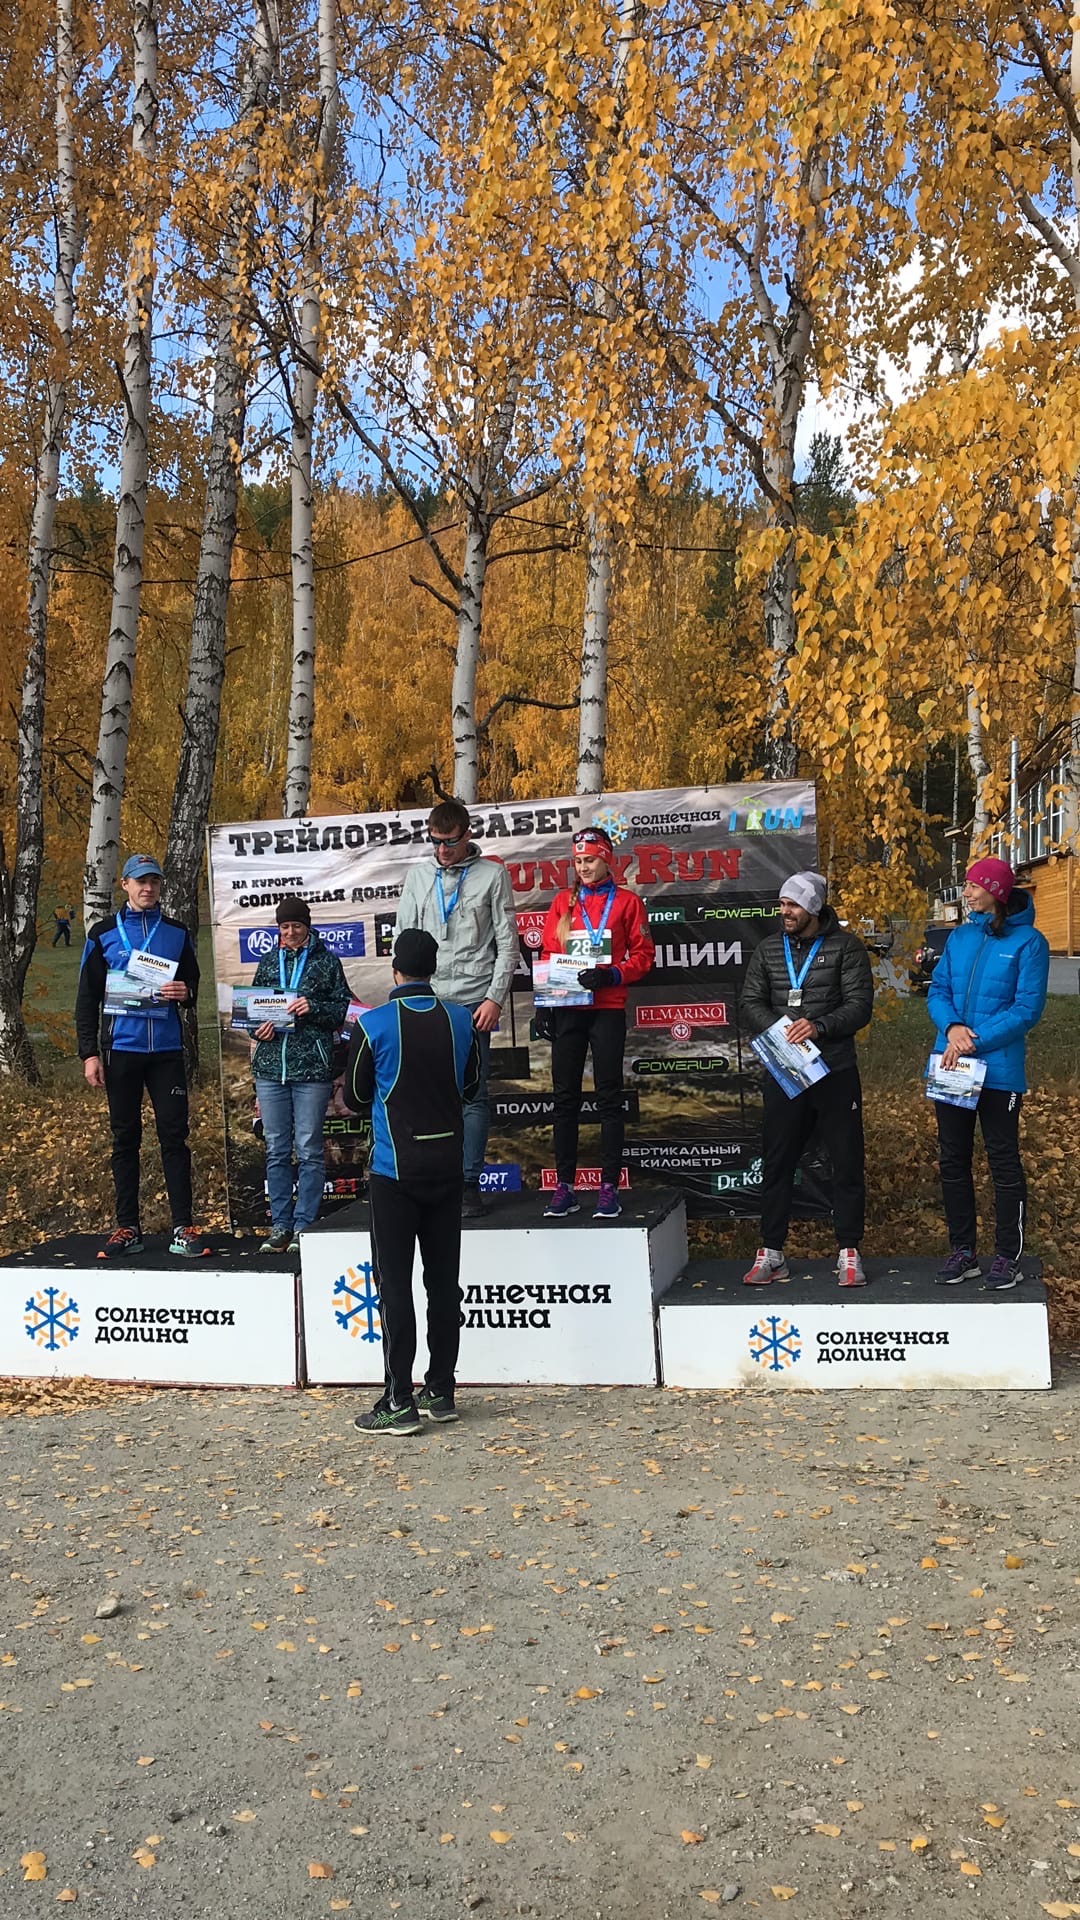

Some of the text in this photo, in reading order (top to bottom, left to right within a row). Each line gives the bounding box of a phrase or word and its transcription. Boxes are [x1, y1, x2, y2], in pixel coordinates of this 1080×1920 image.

[746, 807, 804, 831] RUN
[229, 807, 580, 857] ТРЕЙЛОВЫ ЗАБЕГ
[232, 876, 304, 889] НА КУРОРТЕ
[352, 884, 404, 903] ДОЛИ
[647, 911, 681, 922] rner
[572, 939, 605, 956] 28
[137, 955, 170, 969] ДИПЛОМ
[556, 957, 589, 967] ДИПЛОМ
[639, 1060, 724, 1072] POWERUP
[622, 1144, 741, 1157] ВЕРТИКАЛЬНЫЙ
[640, 1158, 722, 1168] КИЛОМЕТР
[717, 1174, 741, 1191] Dr.
[459, 1284, 612, 1304] лнечная
[95, 1306, 236, 1326] солнечная
[459, 1309, 552, 1329] лина
[94, 1326, 189, 1344] долина
[816, 1330, 950, 1346] солнечная
[816, 1346, 907, 1364] долина
